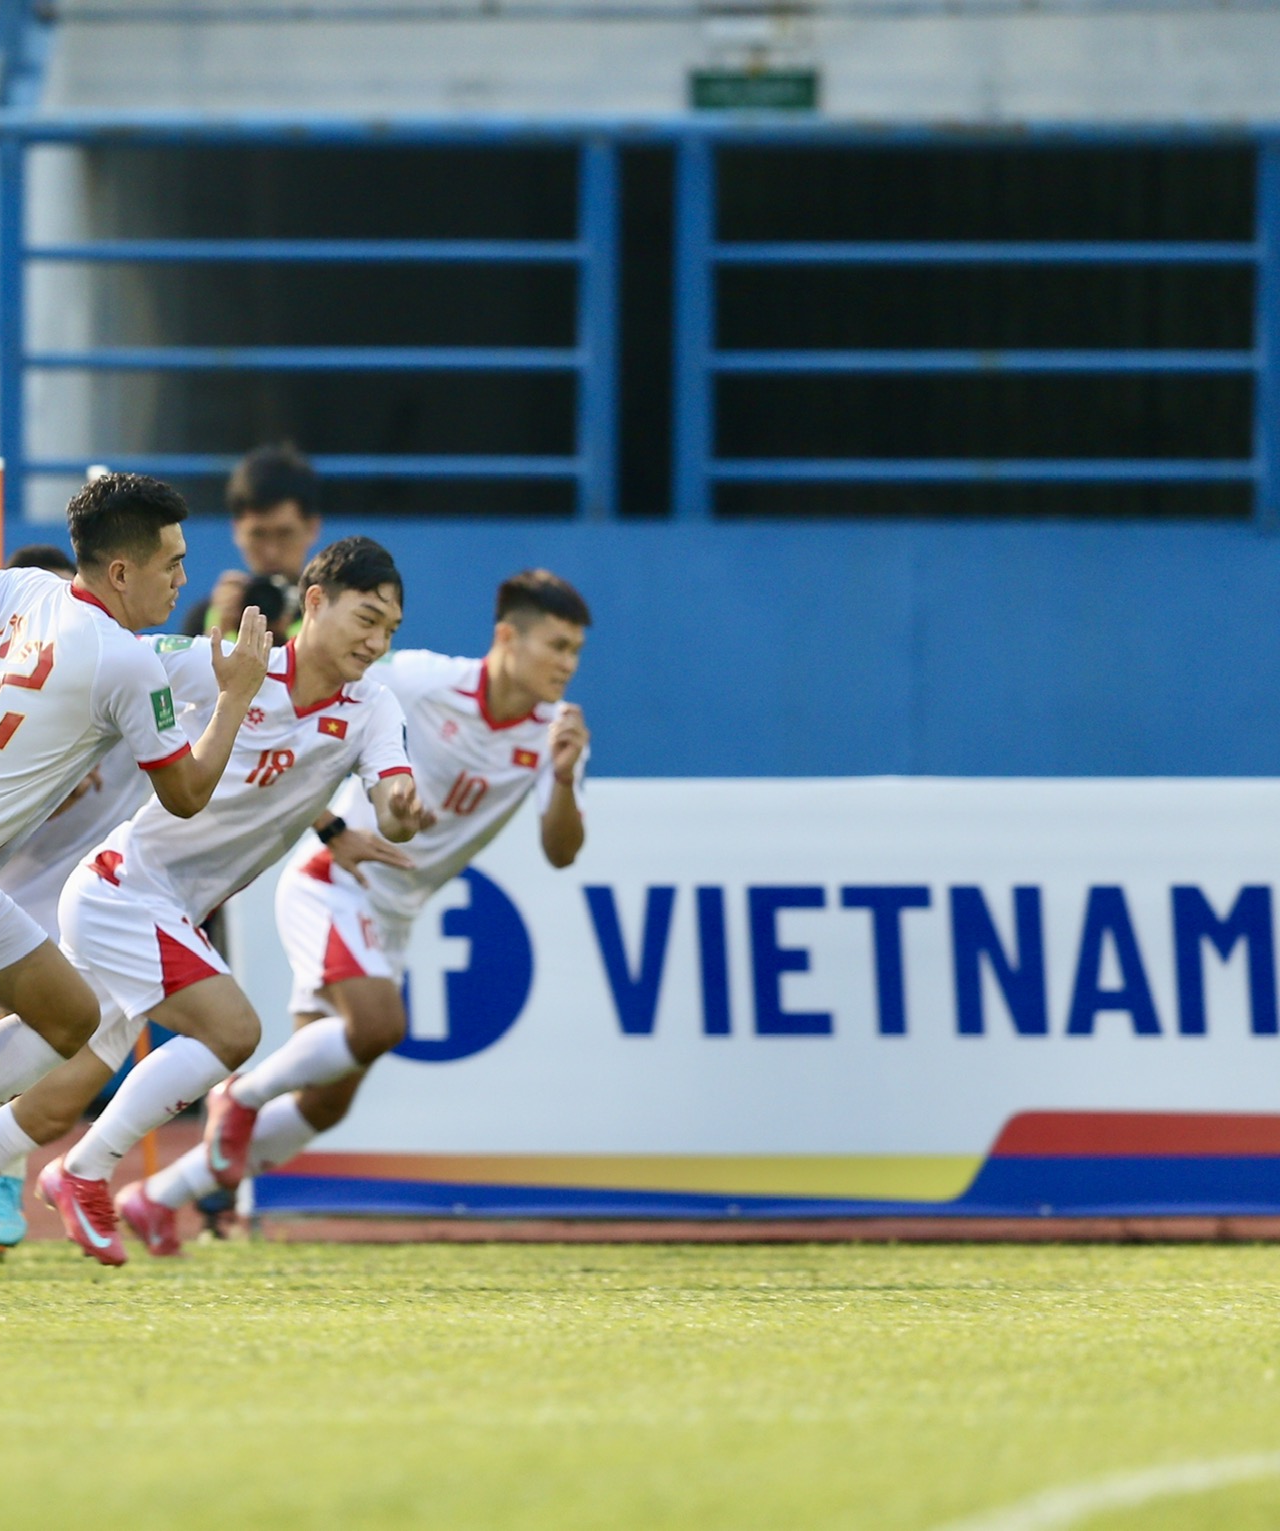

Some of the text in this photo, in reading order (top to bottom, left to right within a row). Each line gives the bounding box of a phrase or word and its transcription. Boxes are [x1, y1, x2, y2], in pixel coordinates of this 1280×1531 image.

[244, 748, 296, 788] 18
[441, 770, 489, 816] 10
[582, 884, 1280, 1037] VIETNAM
